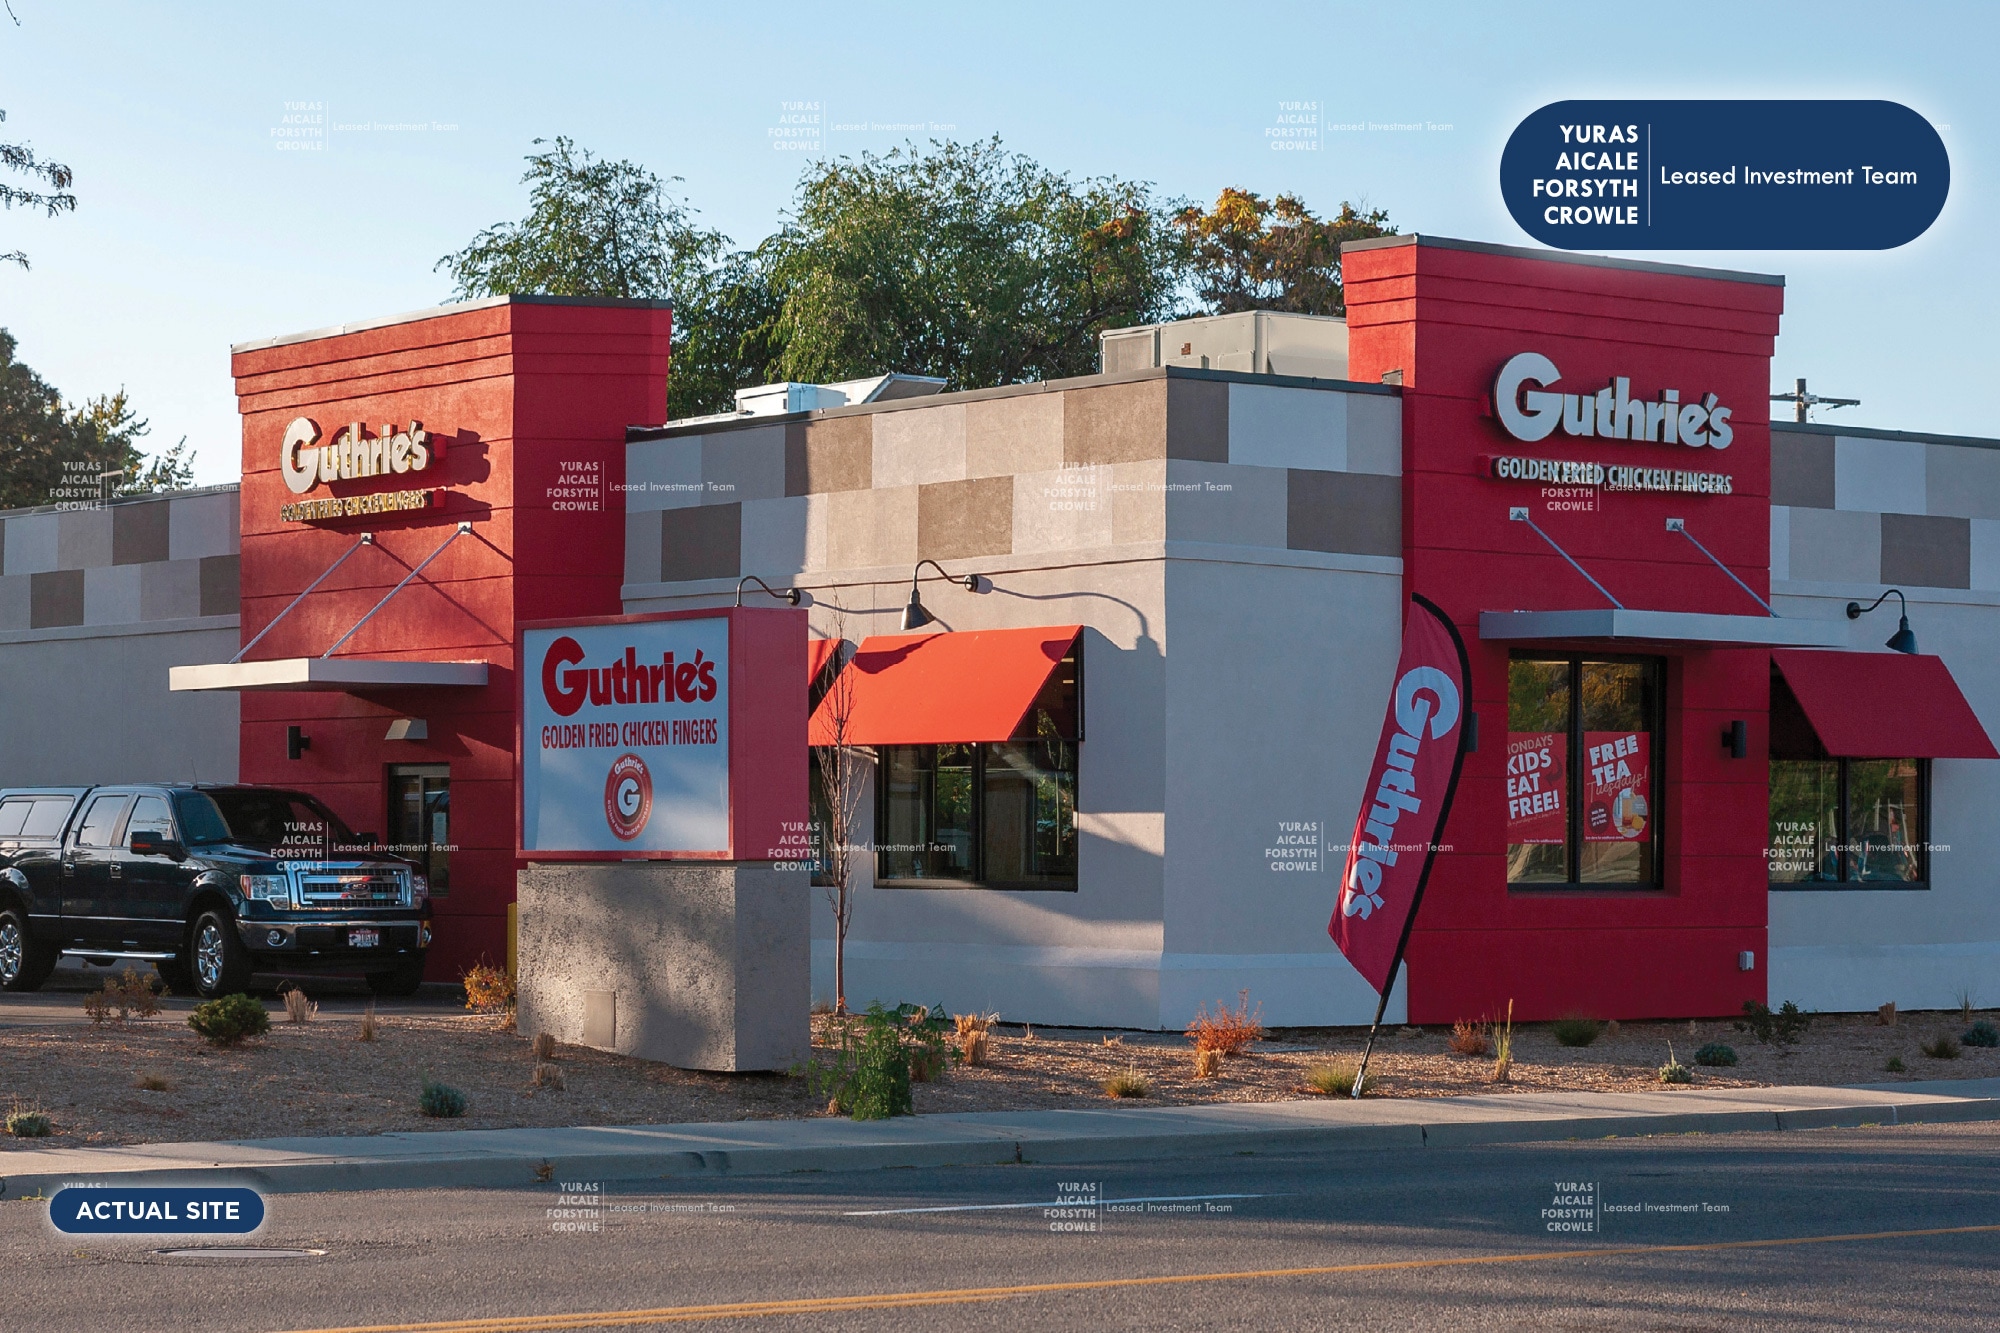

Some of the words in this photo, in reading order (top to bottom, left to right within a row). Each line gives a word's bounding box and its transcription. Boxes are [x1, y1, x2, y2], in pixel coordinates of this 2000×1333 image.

[1495, 352, 1734, 450] Guthrie's
[281, 416, 428, 494] Guthrie's
[1498, 456, 1558, 481] GOLDEN
[1608, 466, 1670, 490] CHICKEN
[1674, 470, 1732, 494] FINGERS
[542, 636, 718, 717] Guthrie's
[542, 724, 586, 750] GOLDEN
[588, 722, 618, 748] FRIED
[622, 720, 669, 746] CHICKEN
[672, 718, 718, 745] FINGERS
[1589, 734, 1639, 766] FREE
[1508, 772, 1540, 798] EAT
[1592, 760, 1632, 786] TEA
[618, 777, 640, 816] G
[1343, 665, 1460, 921] Guthrie's
[1509, 788, 1560, 820] FREE!
